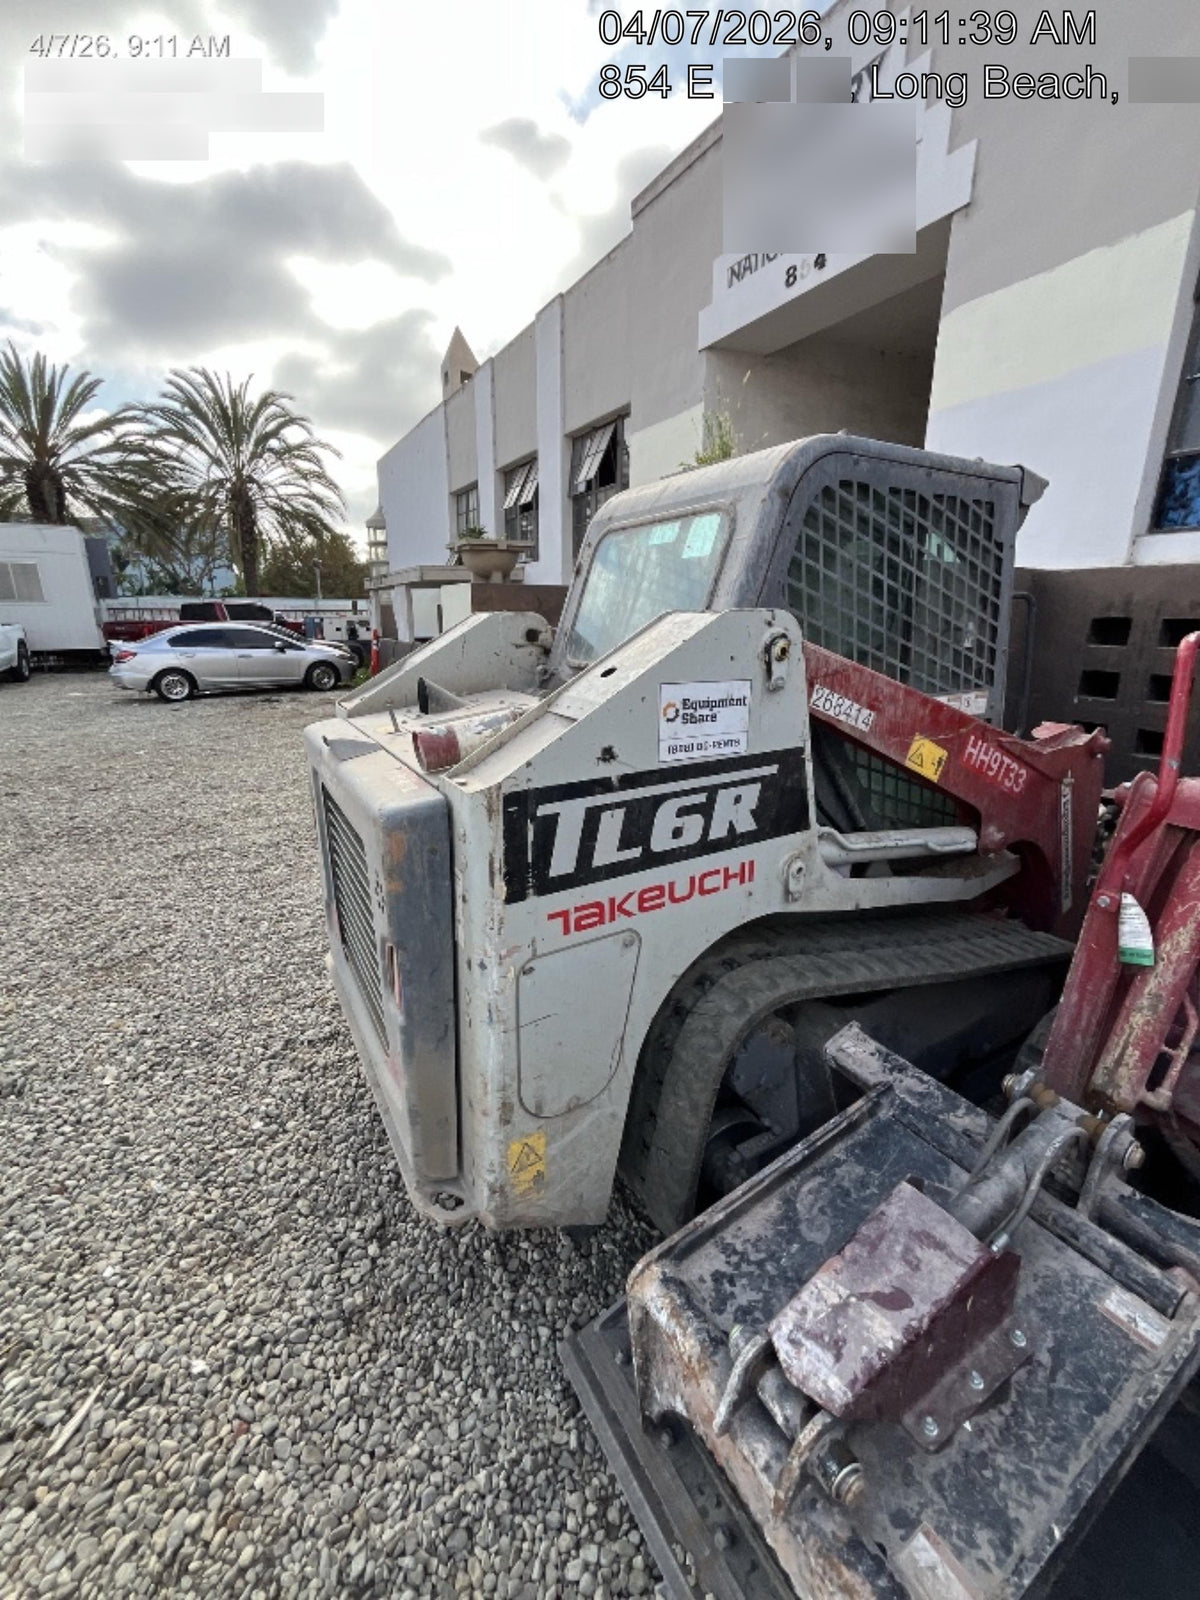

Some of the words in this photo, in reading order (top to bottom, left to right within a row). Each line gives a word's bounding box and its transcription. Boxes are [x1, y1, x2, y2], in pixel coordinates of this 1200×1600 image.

[681, 712, 717, 724] Share
[682, 696, 747, 712] Equipment
[963, 735, 1027, 792] HH9T33
[536, 766, 777, 878] TL6R
[547, 859, 755, 936] TAKEUCHI
